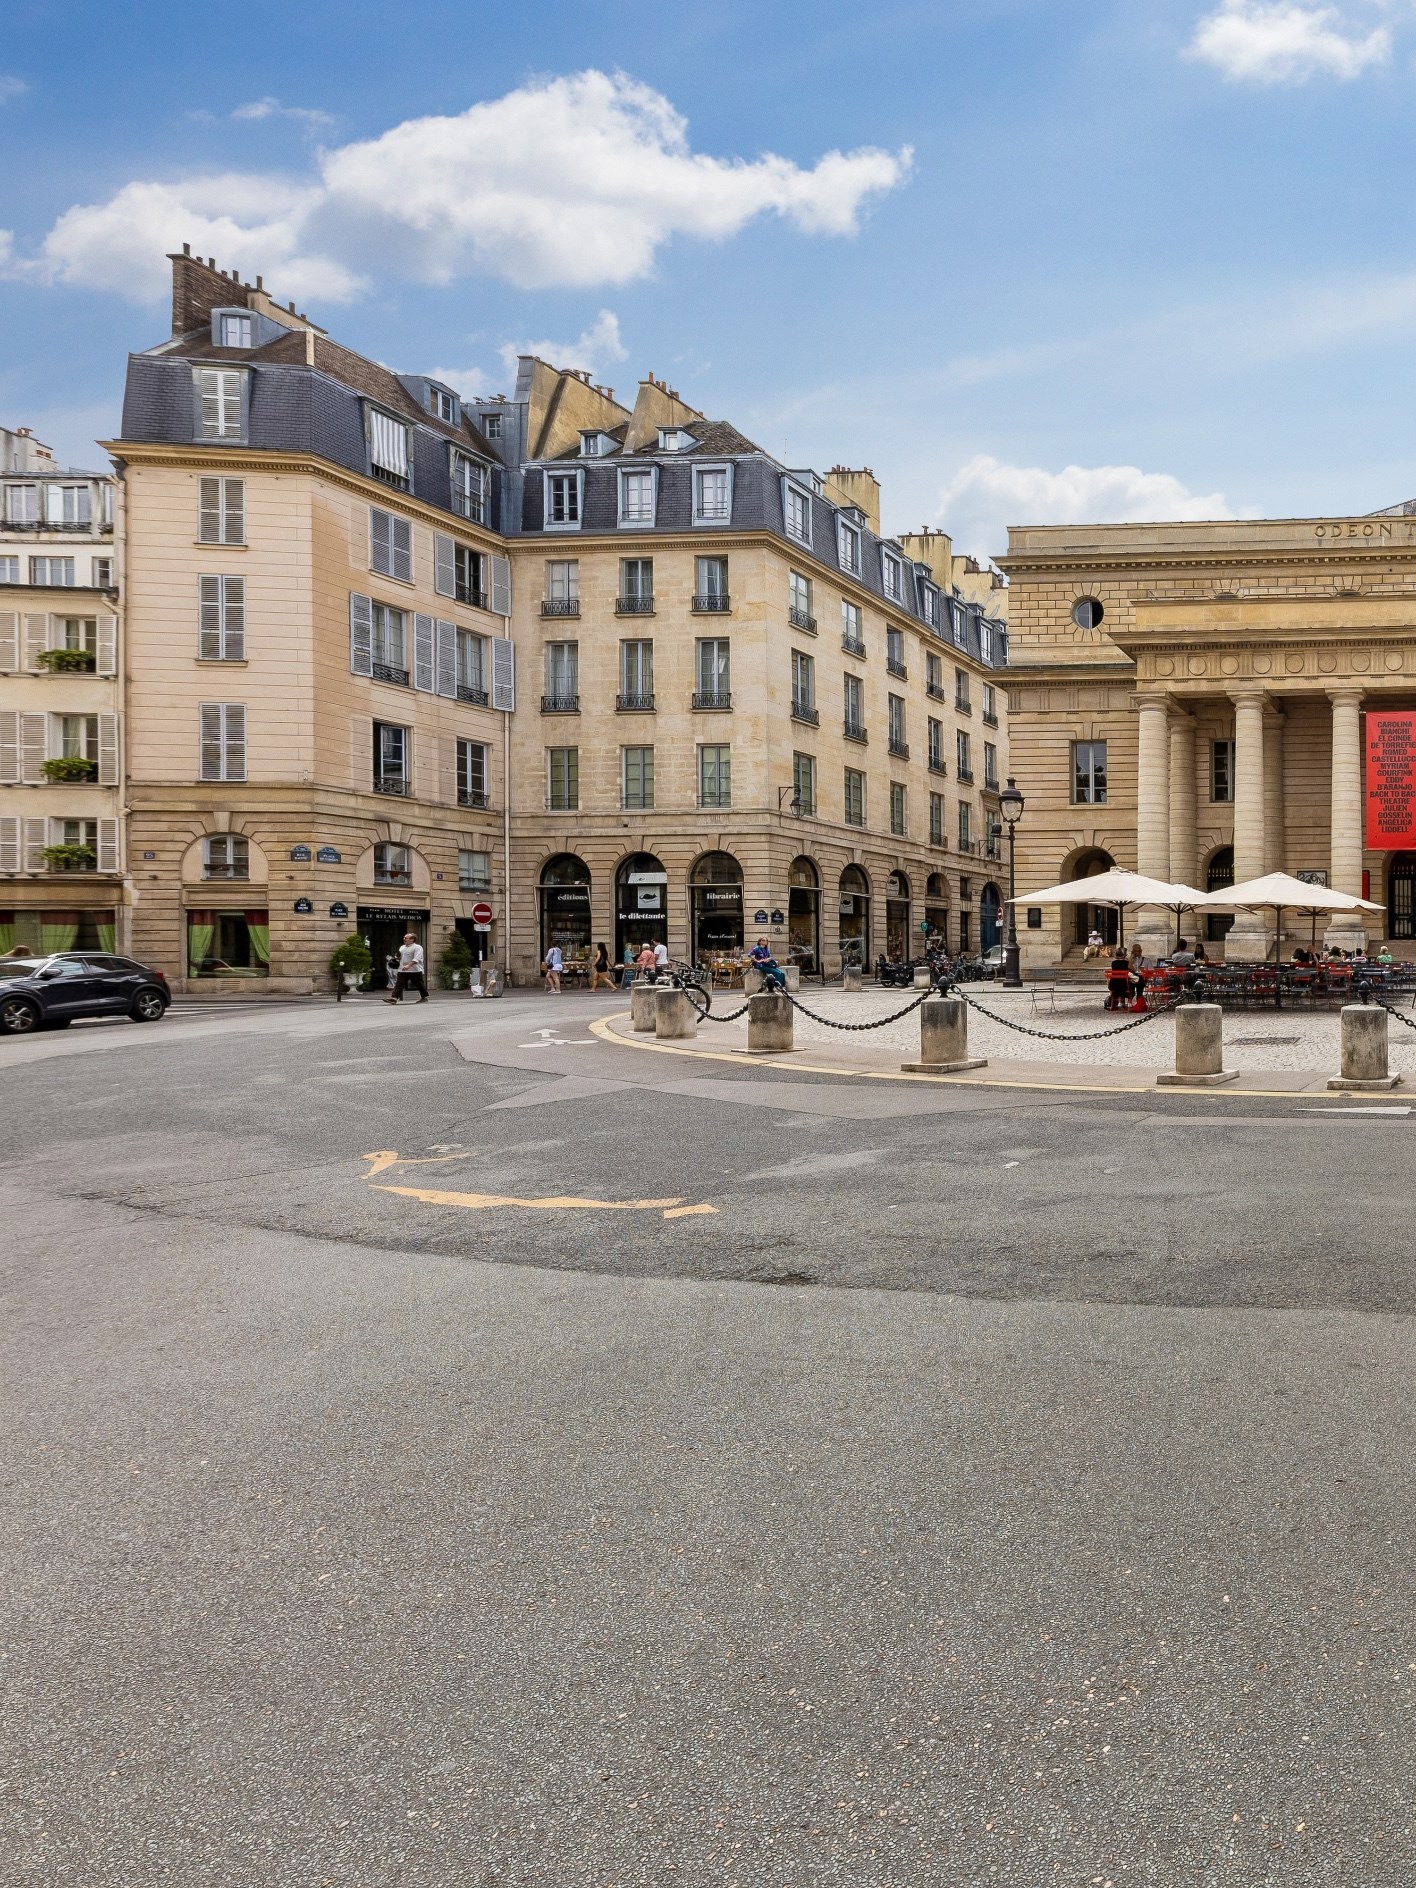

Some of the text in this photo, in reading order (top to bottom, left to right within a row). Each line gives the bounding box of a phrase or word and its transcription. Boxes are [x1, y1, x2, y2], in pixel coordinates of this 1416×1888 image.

[1314, 523, 1392, 538] ODEON
[706, 892, 740, 900] librairie
[628, 912, 666, 920] dilettante
